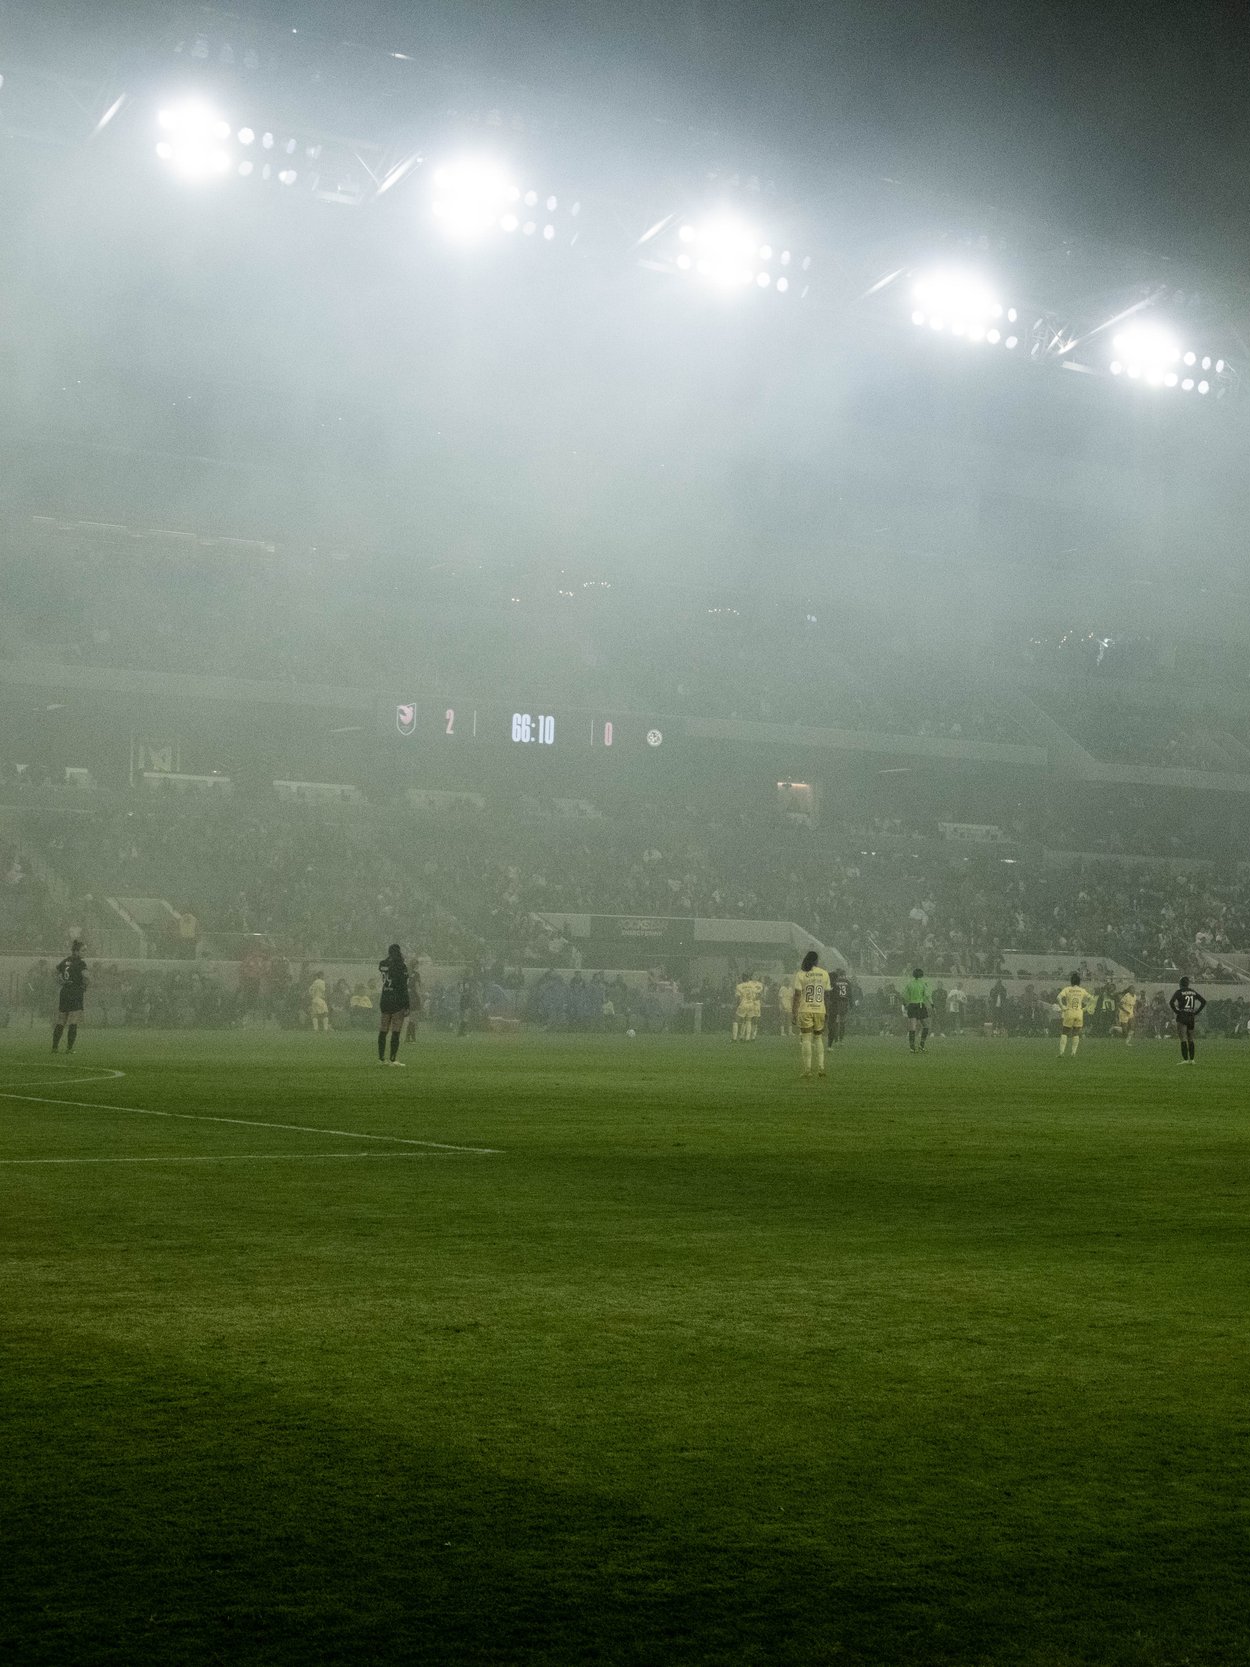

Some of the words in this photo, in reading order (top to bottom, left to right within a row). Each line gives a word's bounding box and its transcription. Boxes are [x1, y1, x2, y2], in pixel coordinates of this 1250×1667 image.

[445, 709, 455, 734] 2
[511, 713, 555, 745] 66:10
[604, 722, 613, 746] 0
[805, 984, 824, 1003] 28
[1184, 995, 1194, 1008] 21
